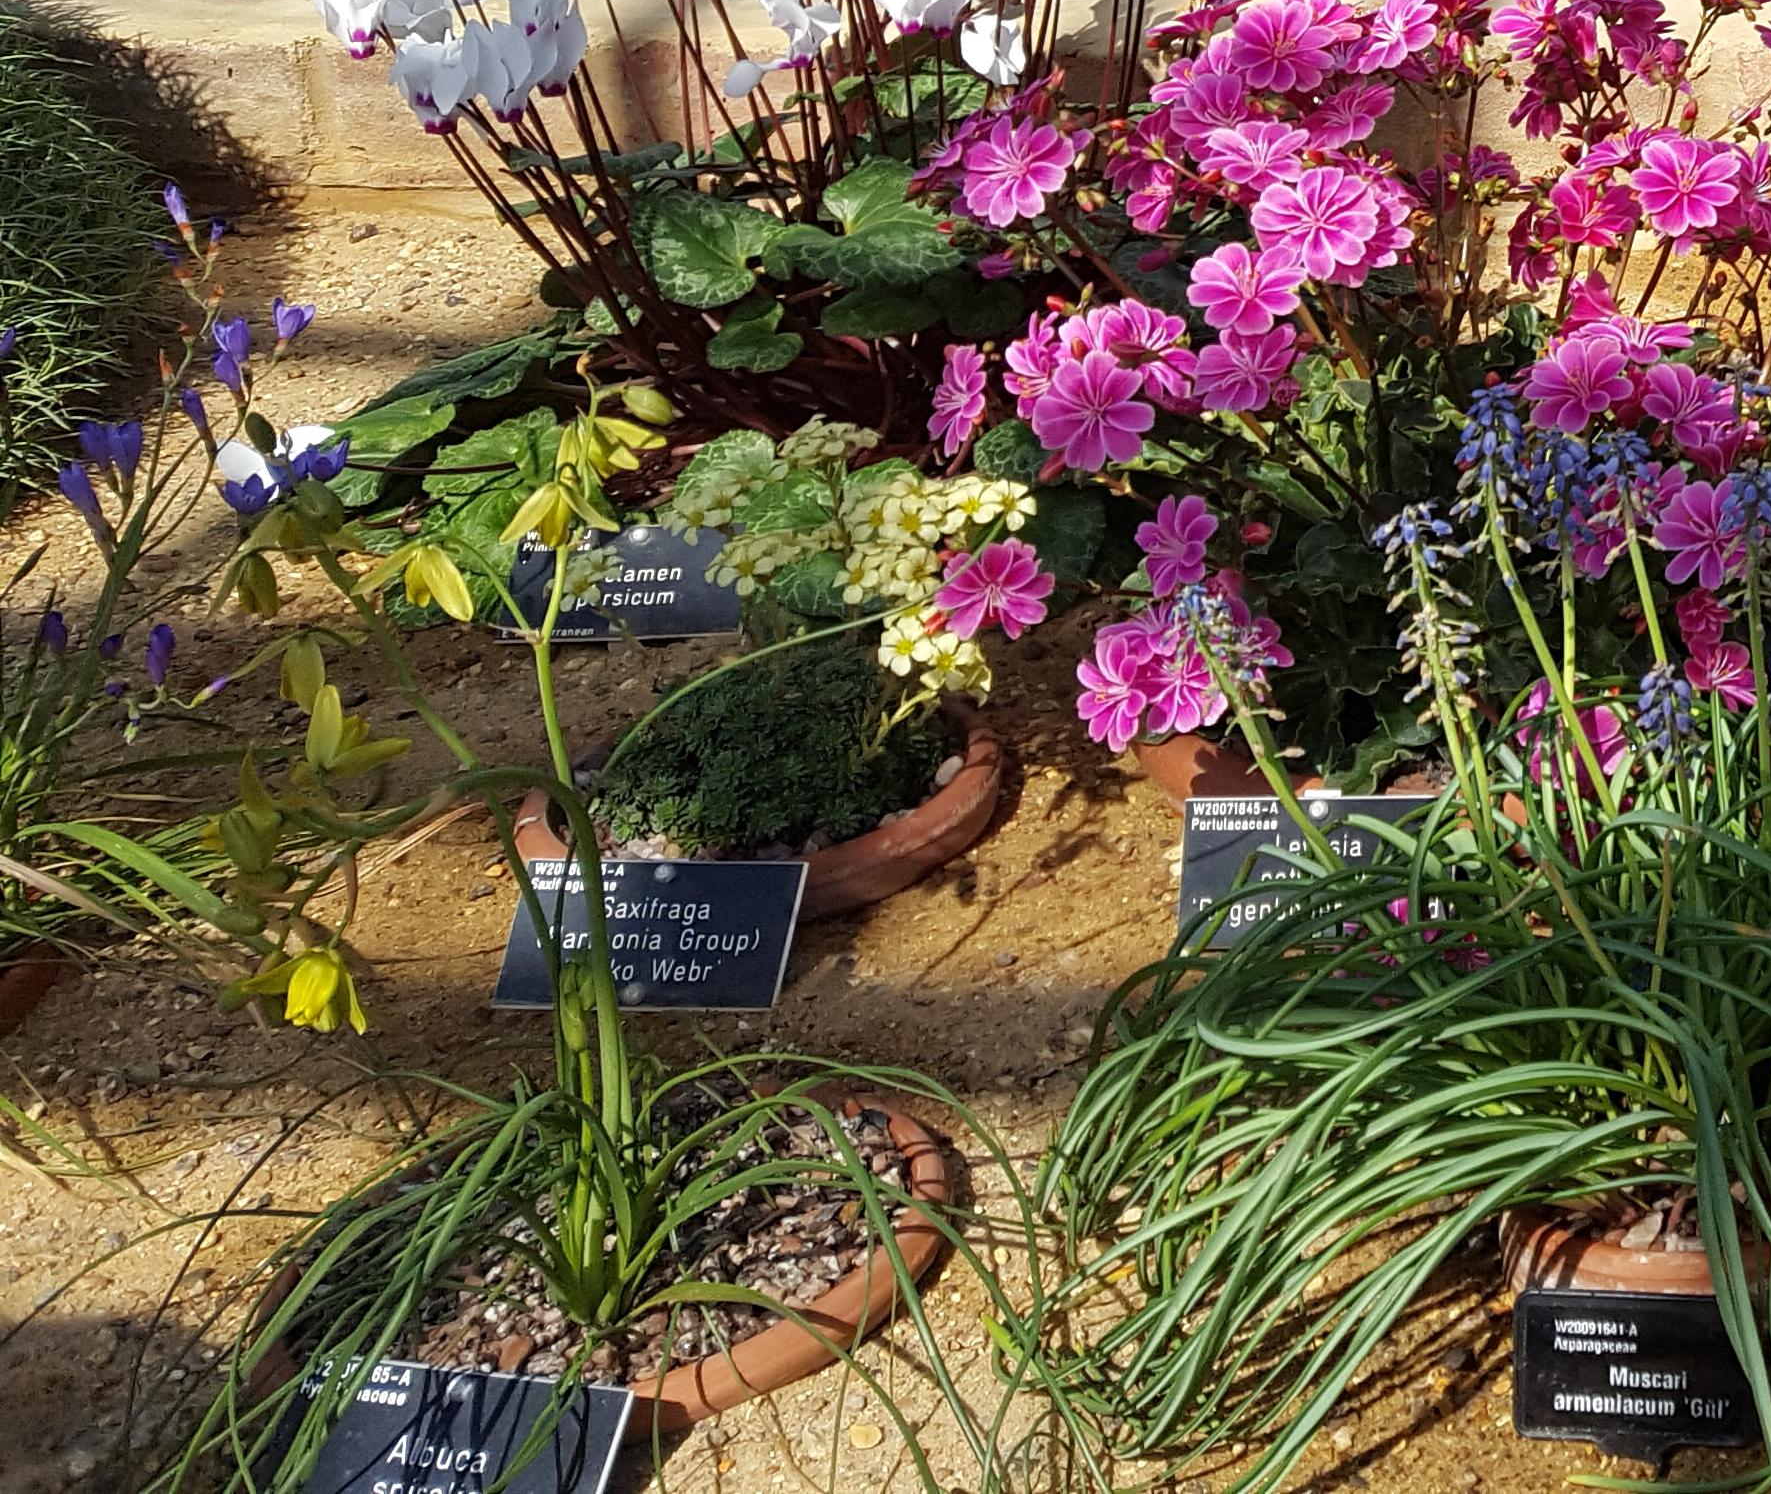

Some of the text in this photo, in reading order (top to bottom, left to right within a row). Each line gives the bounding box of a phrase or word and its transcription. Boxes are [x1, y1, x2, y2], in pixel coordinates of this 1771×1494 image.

[604, 896, 711, 926] Saxifraga
[679, 928, 760, 957] Group)
[1553, 1336, 1637, 1355] Asparagaceae
[1609, 1363, 1687, 1390] Muscari
[1553, 1391, 1675, 1417] armeniacum
[386, 1434, 488, 1474] Albuca
